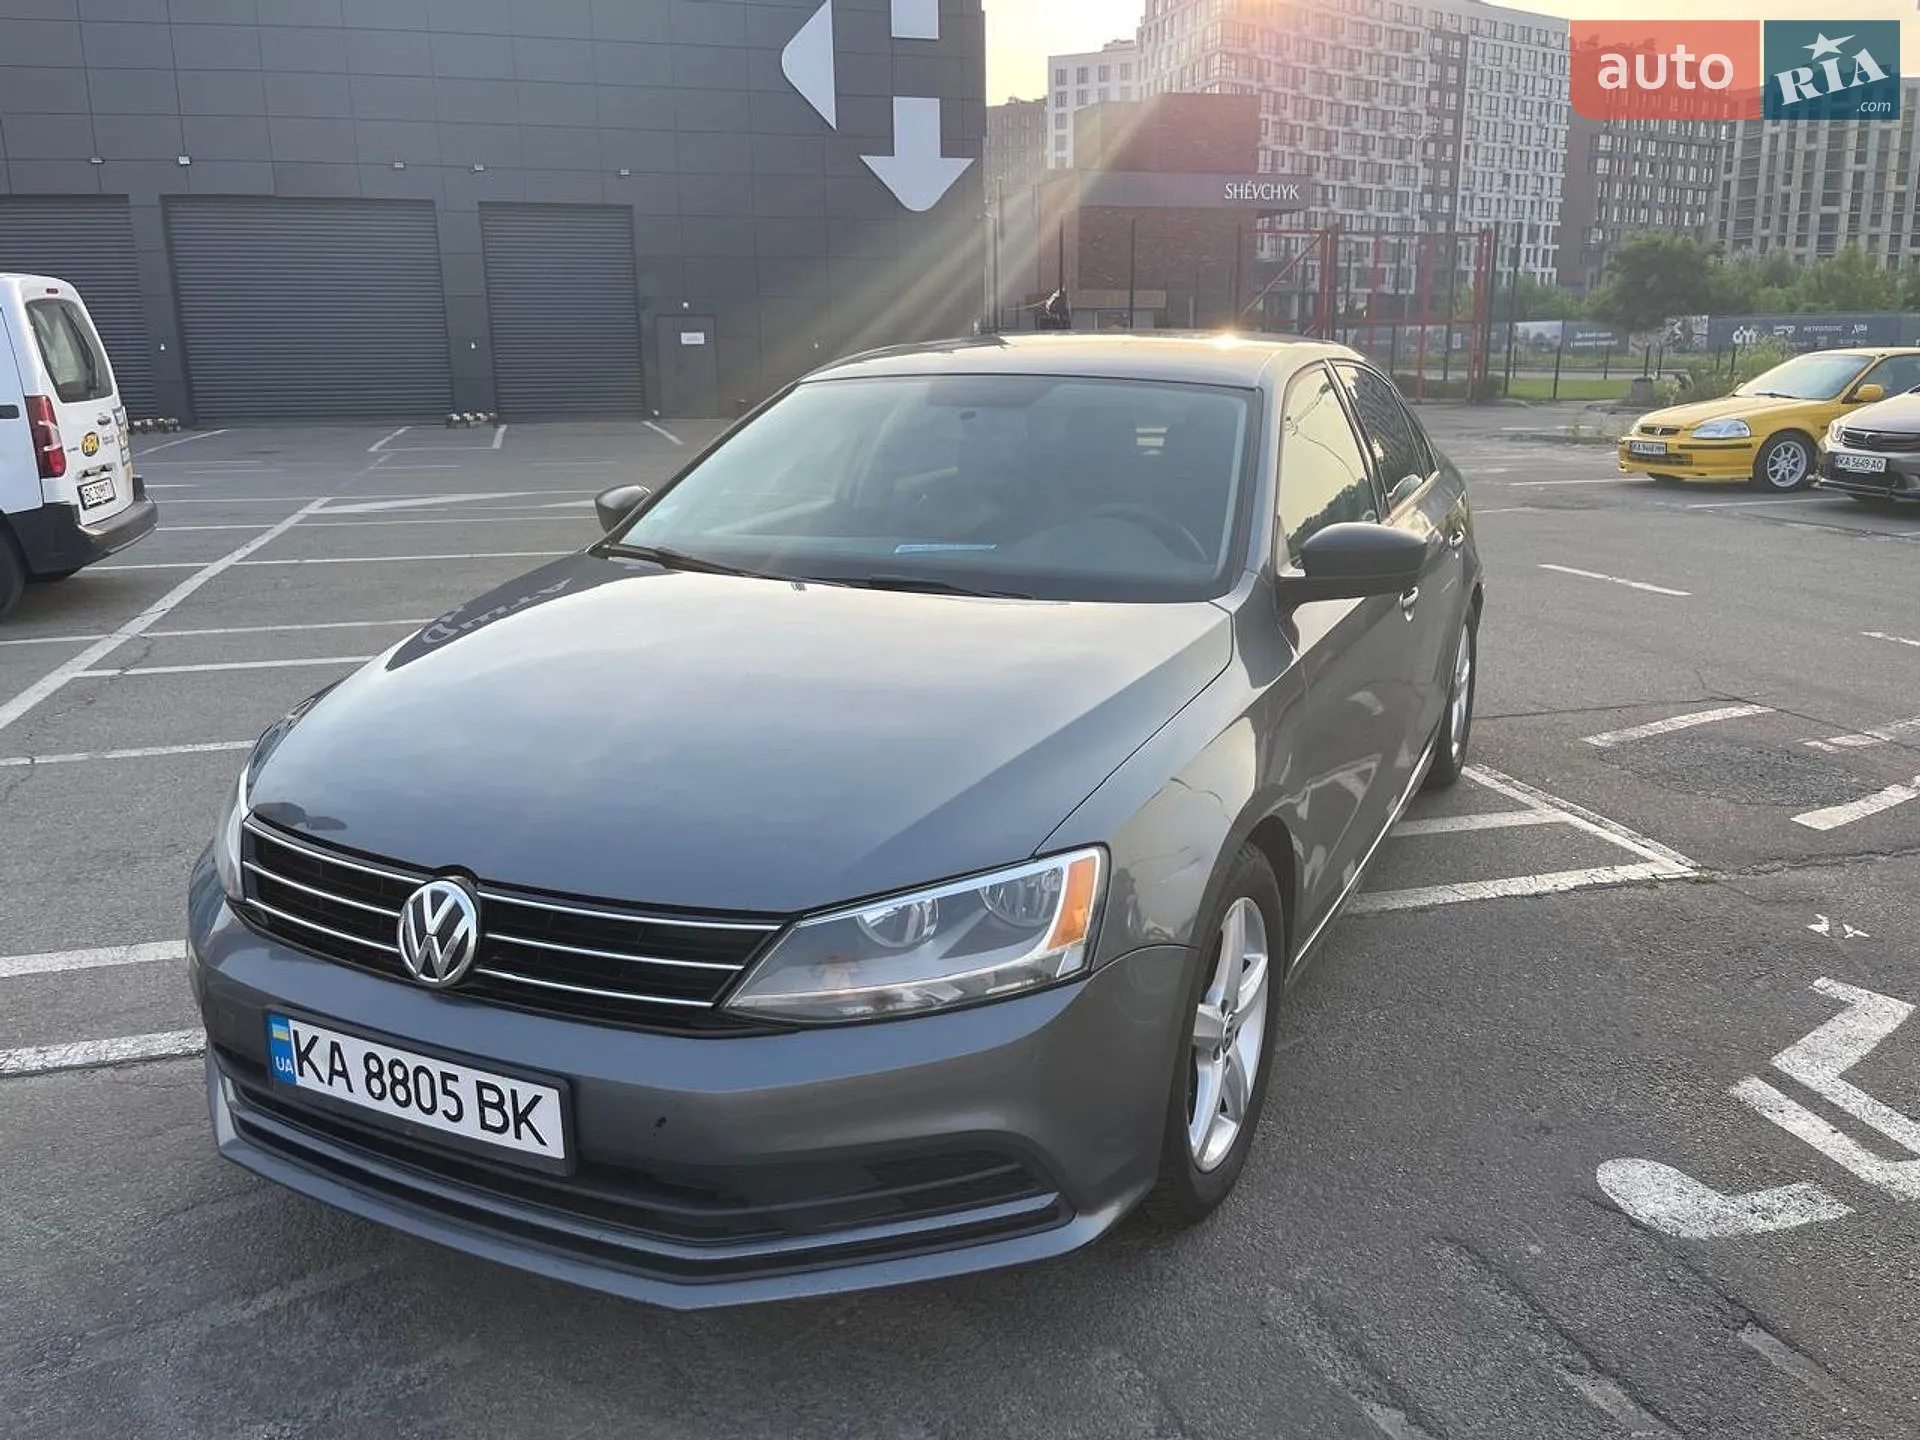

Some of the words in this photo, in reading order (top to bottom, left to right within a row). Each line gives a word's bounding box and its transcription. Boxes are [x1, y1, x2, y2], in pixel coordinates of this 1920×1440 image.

[274, 1056, 294, 1075] UA
[292, 1029, 354, 1093] KA
[363, 1051, 464, 1123] 8805
[476, 1079, 547, 1147] BK
